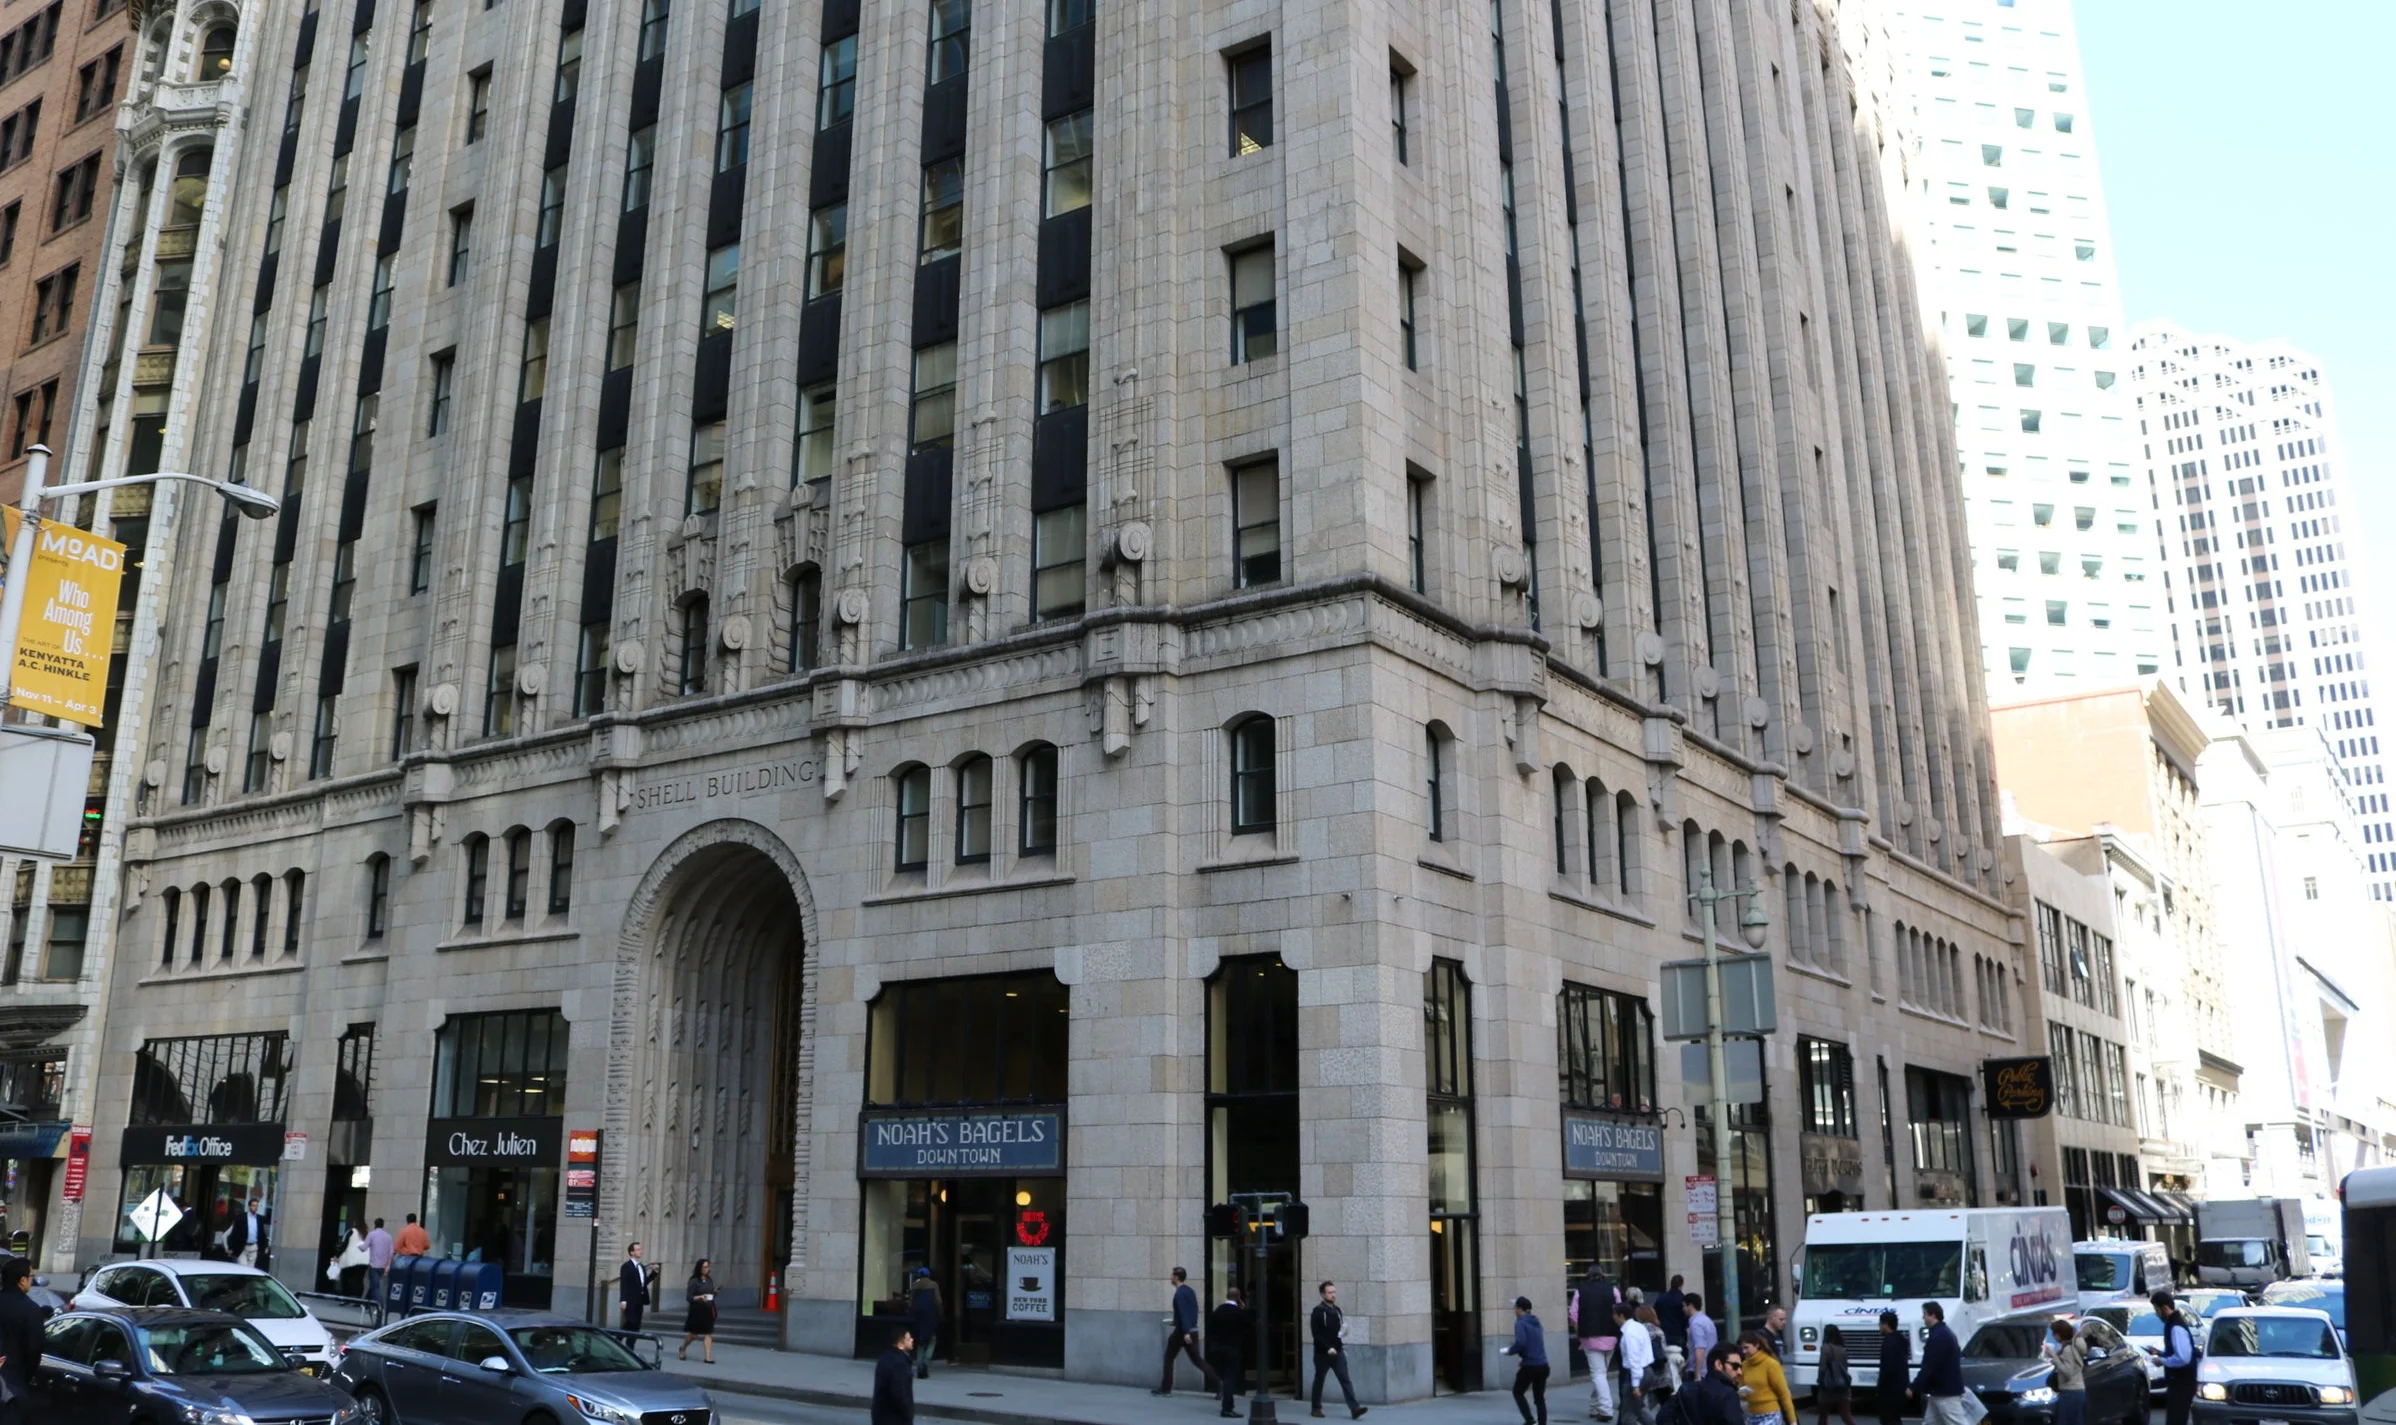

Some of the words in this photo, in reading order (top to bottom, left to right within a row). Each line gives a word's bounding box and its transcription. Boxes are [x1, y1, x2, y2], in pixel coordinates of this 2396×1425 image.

[58, 578, 90, 609] Who
[42, 597, 94, 637] Among
[19, 647, 85, 669] KENYATTA
[18, 659, 41, 671] A.C.
[43, 664, 91, 681] HINKLE
[16, 686, 40, 700] Nov
[42, 694, 52, 705] 11
[65, 698, 88, 712] Apr
[89, 705, 97, 715] 3
[636, 781, 696, 810] SHELL
[706, 760, 813, 799] BUILDING
[449, 1132, 488, 1156] Chez
[493, 1131, 537, 1156] Julien
[877, 1122, 949, 1146] NOAH'S
[959, 1120, 1045, 1144] BAGELS
[1572, 1123, 1612, 1148] NOAH'S
[1615, 1127, 1655, 1151] BAGELS
[164, 1135, 198, 1157] FedEx
[199, 1137, 232, 1157] Office
[916, 1148, 1001, 1165] DOWNTOWN
[1595, 1151, 1638, 1168] DOWNTOWN
[1013, 1253, 1049, 1266] NOAH'S
[2010, 1220, 2057, 1288] CINTAS
[1012, 1302, 1048, 1313] COFFEE
[1844, 1306, 1897, 1314] CINTAS
